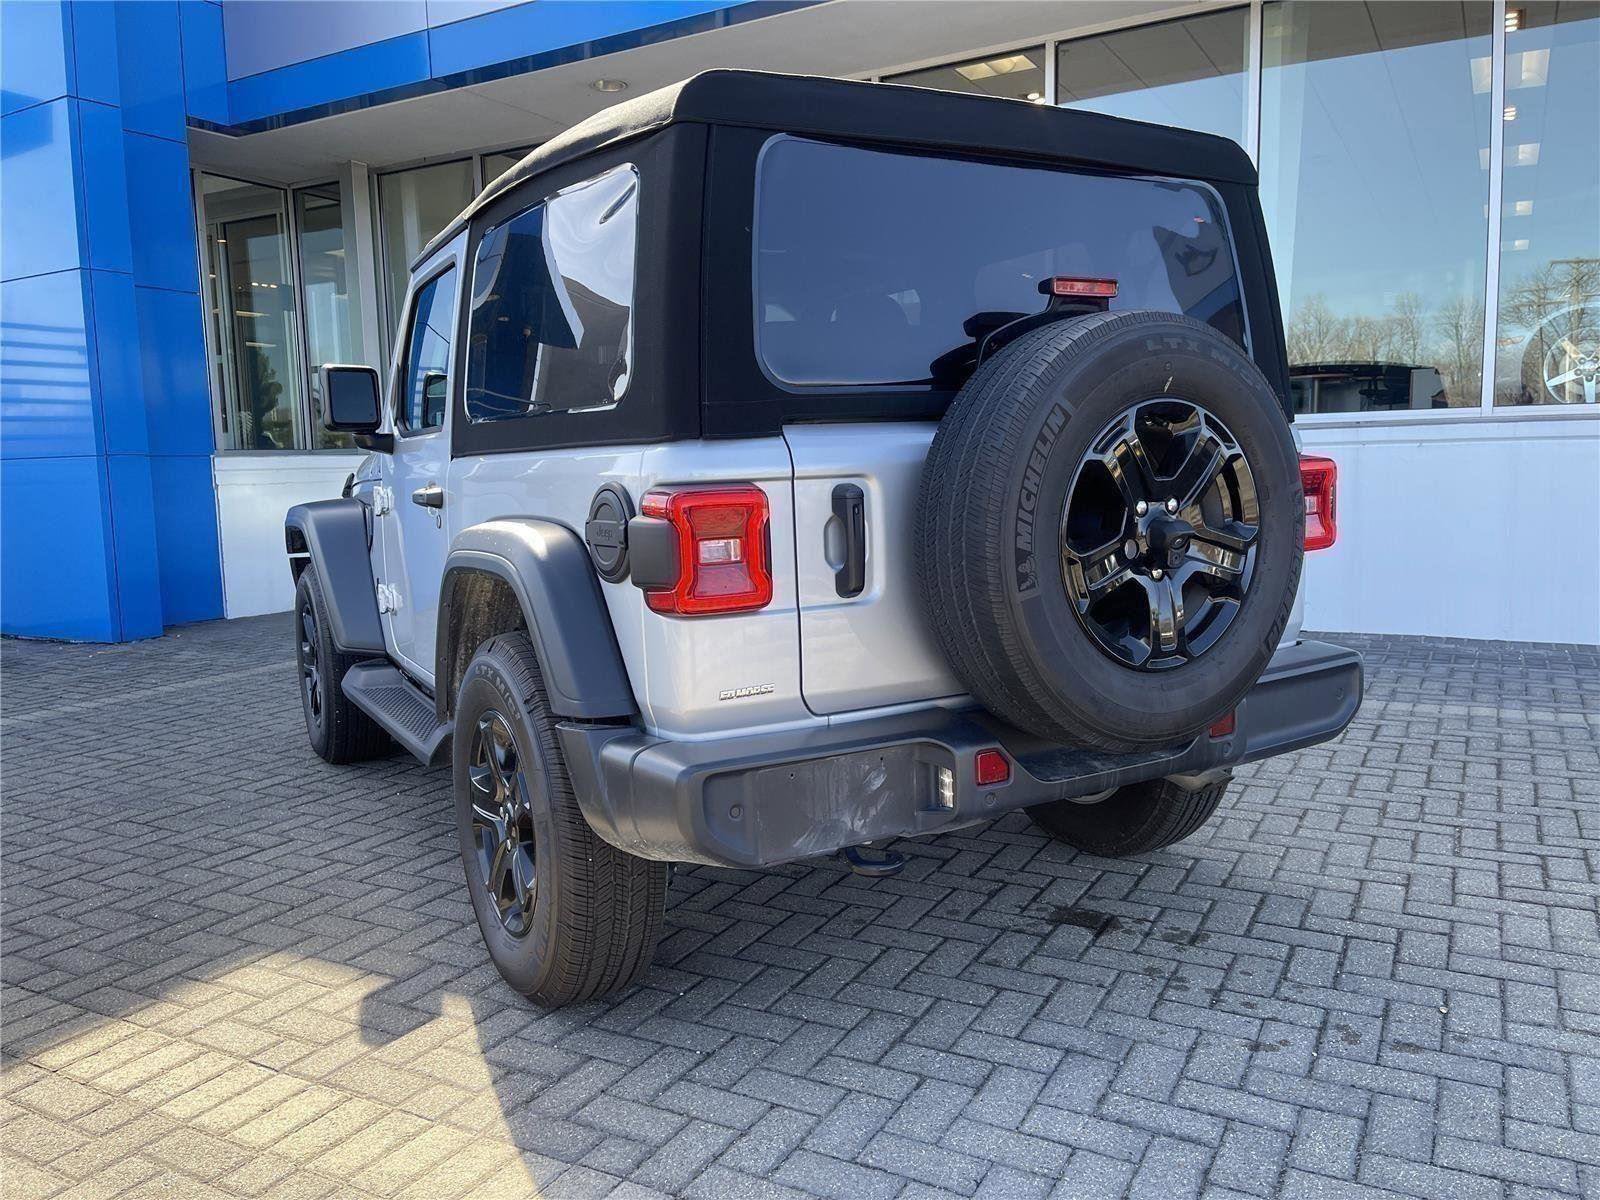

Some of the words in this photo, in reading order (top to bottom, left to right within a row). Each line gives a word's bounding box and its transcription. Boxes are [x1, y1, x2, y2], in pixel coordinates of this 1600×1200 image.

[1145, 337, 1201, 353] LTX
[1018, 404, 1068, 550] MICHELIN
[475, 665, 494, 680] LTX
